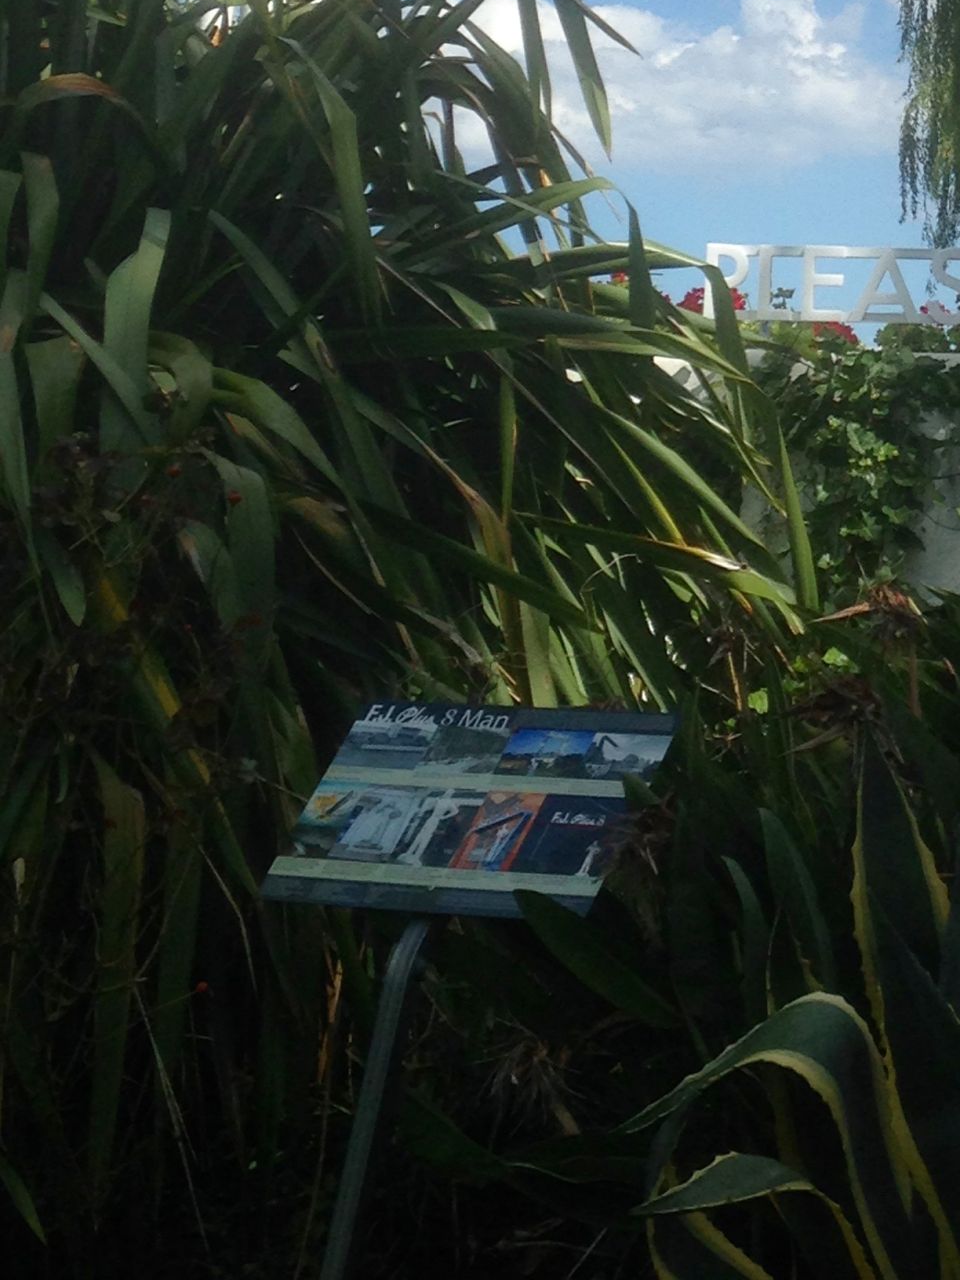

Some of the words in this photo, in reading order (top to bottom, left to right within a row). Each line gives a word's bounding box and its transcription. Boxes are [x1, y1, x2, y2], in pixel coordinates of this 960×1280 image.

[397, 706, 436, 725] Plus
[441, 709, 457, 726] 8
[457, 709, 509, 729] Man
